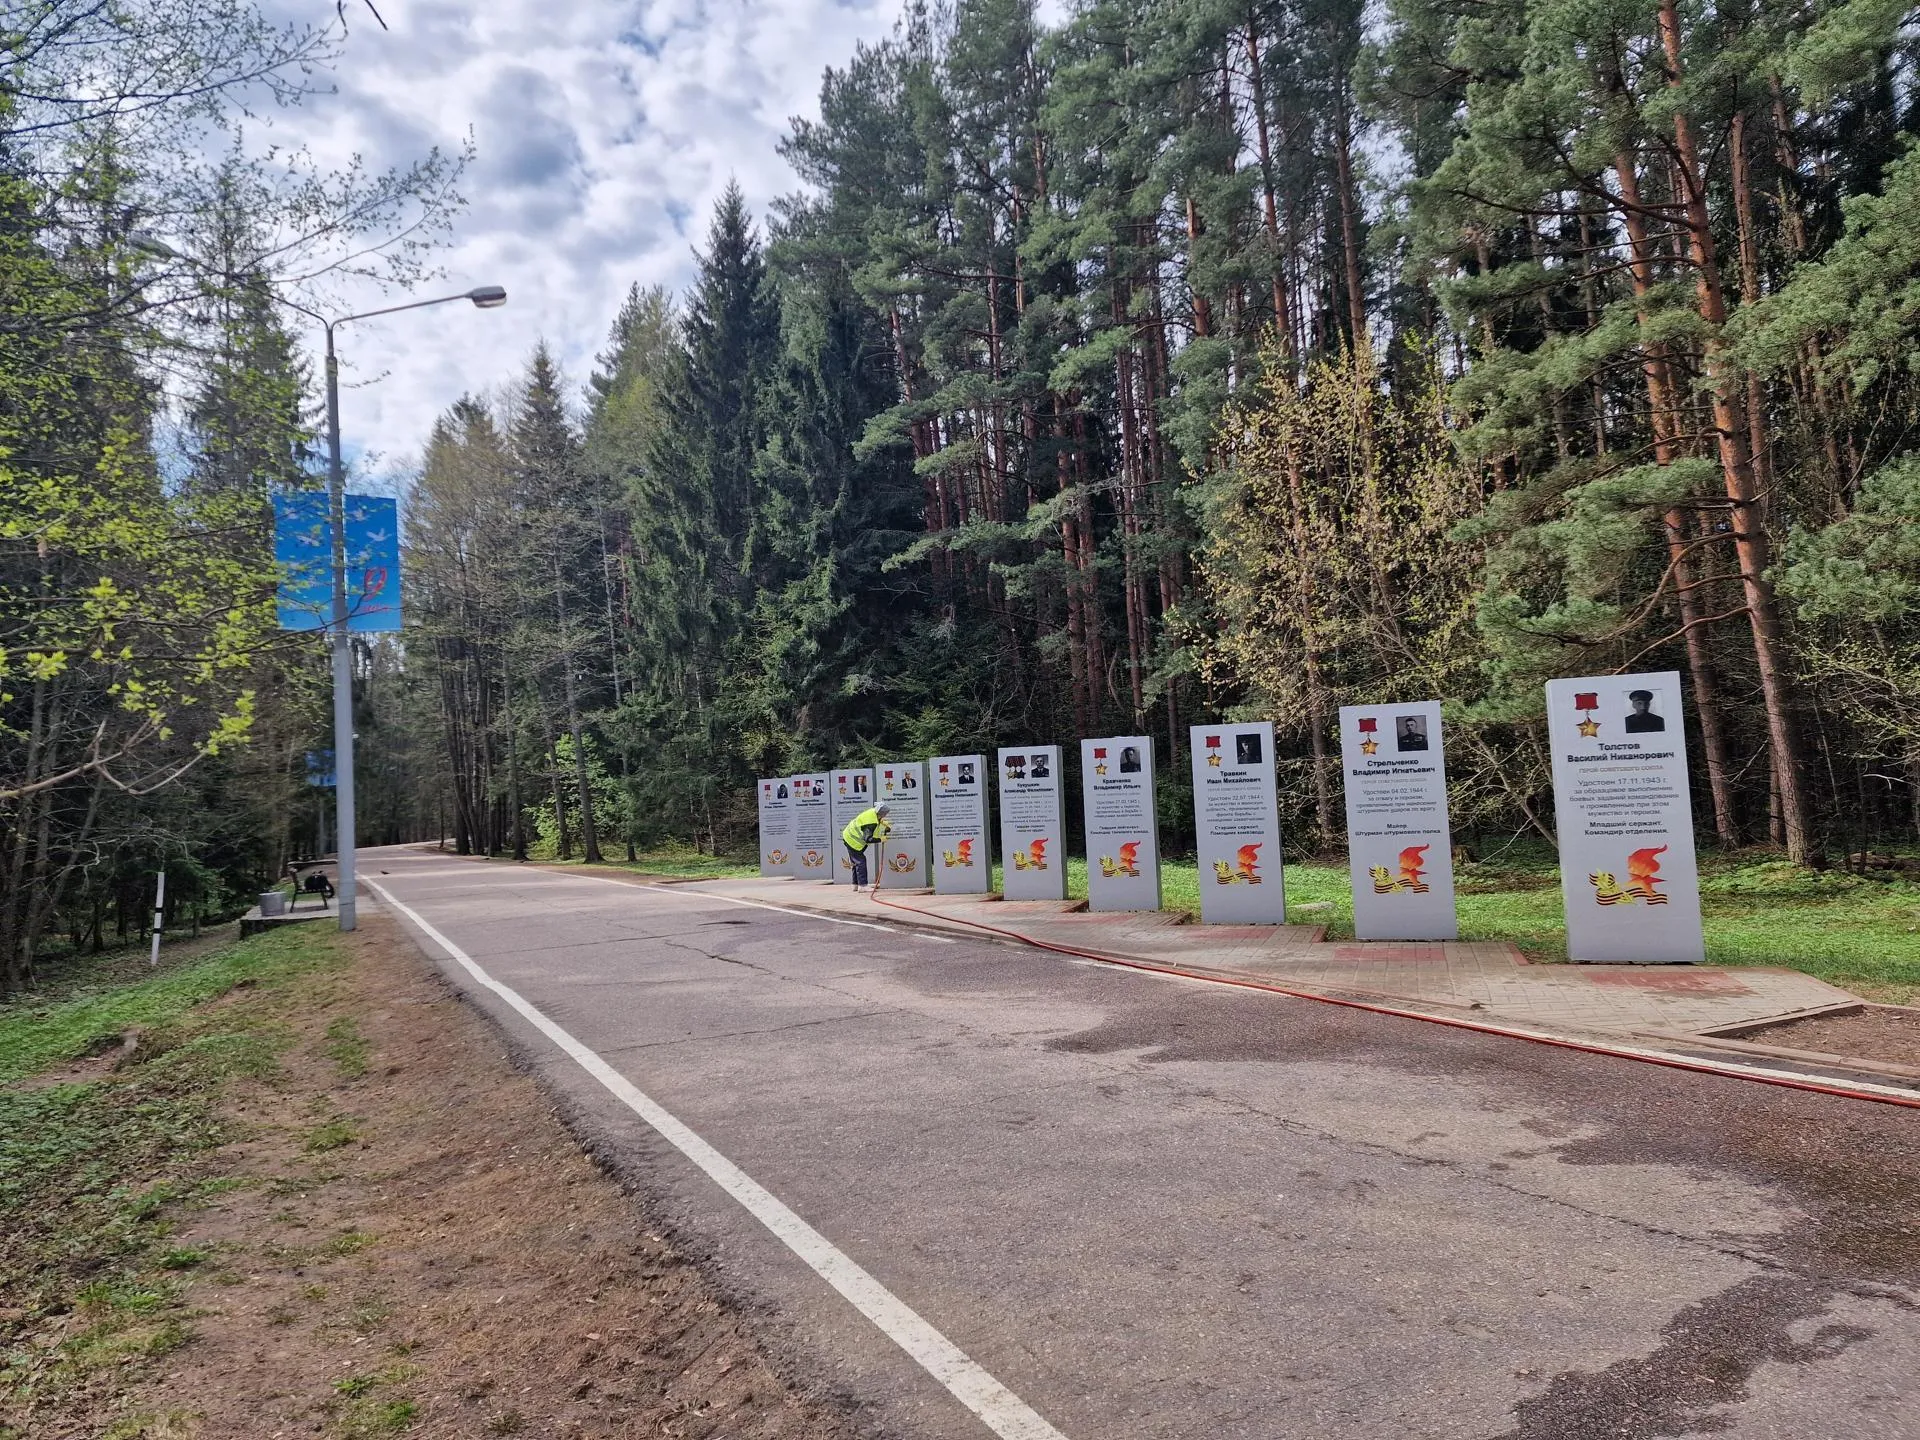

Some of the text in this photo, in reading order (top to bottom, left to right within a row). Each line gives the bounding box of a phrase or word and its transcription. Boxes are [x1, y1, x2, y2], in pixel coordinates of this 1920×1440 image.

[1598, 743, 1640, 751] Толстов
[1567, 752, 1674, 763] Василий Никанорович
[1578, 779, 1615, 787] Удостоен
[1618, 777, 1661, 785] 17.11.1943
